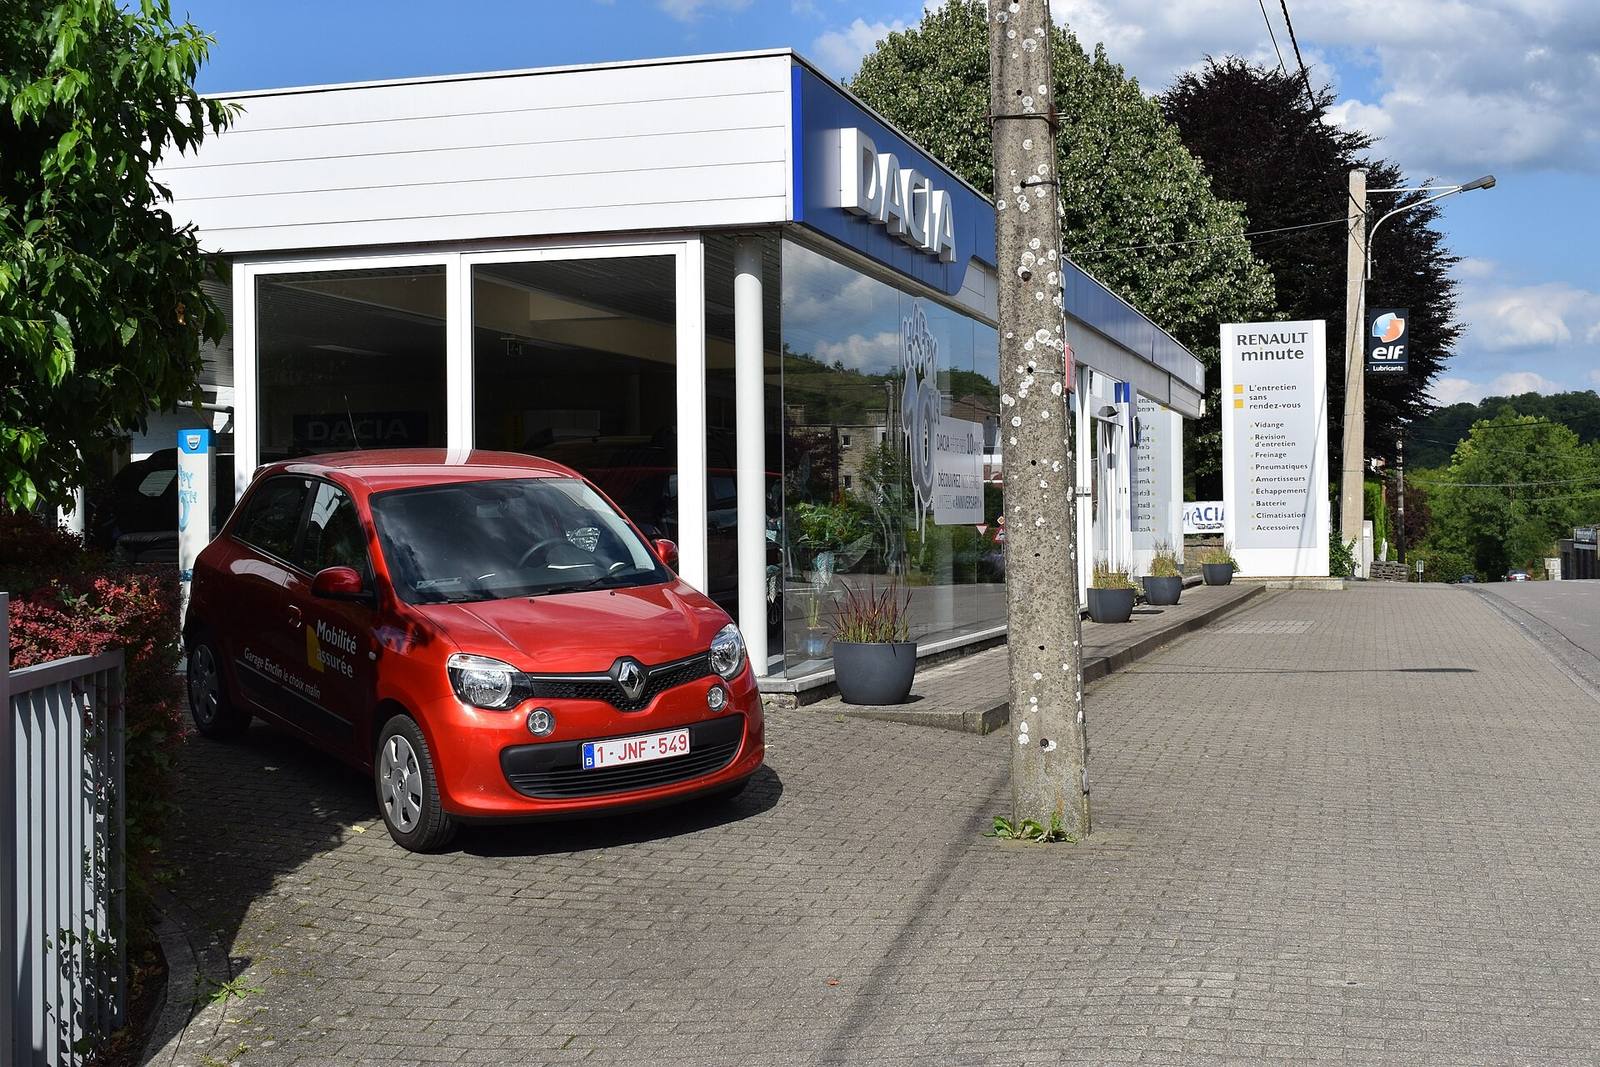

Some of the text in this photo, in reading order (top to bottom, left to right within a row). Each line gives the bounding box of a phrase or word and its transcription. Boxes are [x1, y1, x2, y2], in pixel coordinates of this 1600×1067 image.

[840, 128, 957, 263] DACIA
[1237, 332, 1308, 346] RENAULT
[1241, 347, 1305, 361] minute
[1372, 345, 1404, 360] elf
[1249, 384, 1297, 392] L'entretien
[1249, 401, 1301, 409] rendez-vous
[307, 418, 409, 441] DACIA
[1254, 421, 1284, 429] Vidange
[1255, 440, 1296, 448] d'entretien
[1255, 451, 1287, 459] Freinage
[1255, 463, 1308, 471] Pneumatiques
[316, 619, 357, 655] Mobilité
[316, 647, 353, 679] assurée
[244, 647, 321, 699] Garage Enclin le choix malin
[596, 734, 687, 763] 1-JNF-549
[586, 757, 593, 766] B
